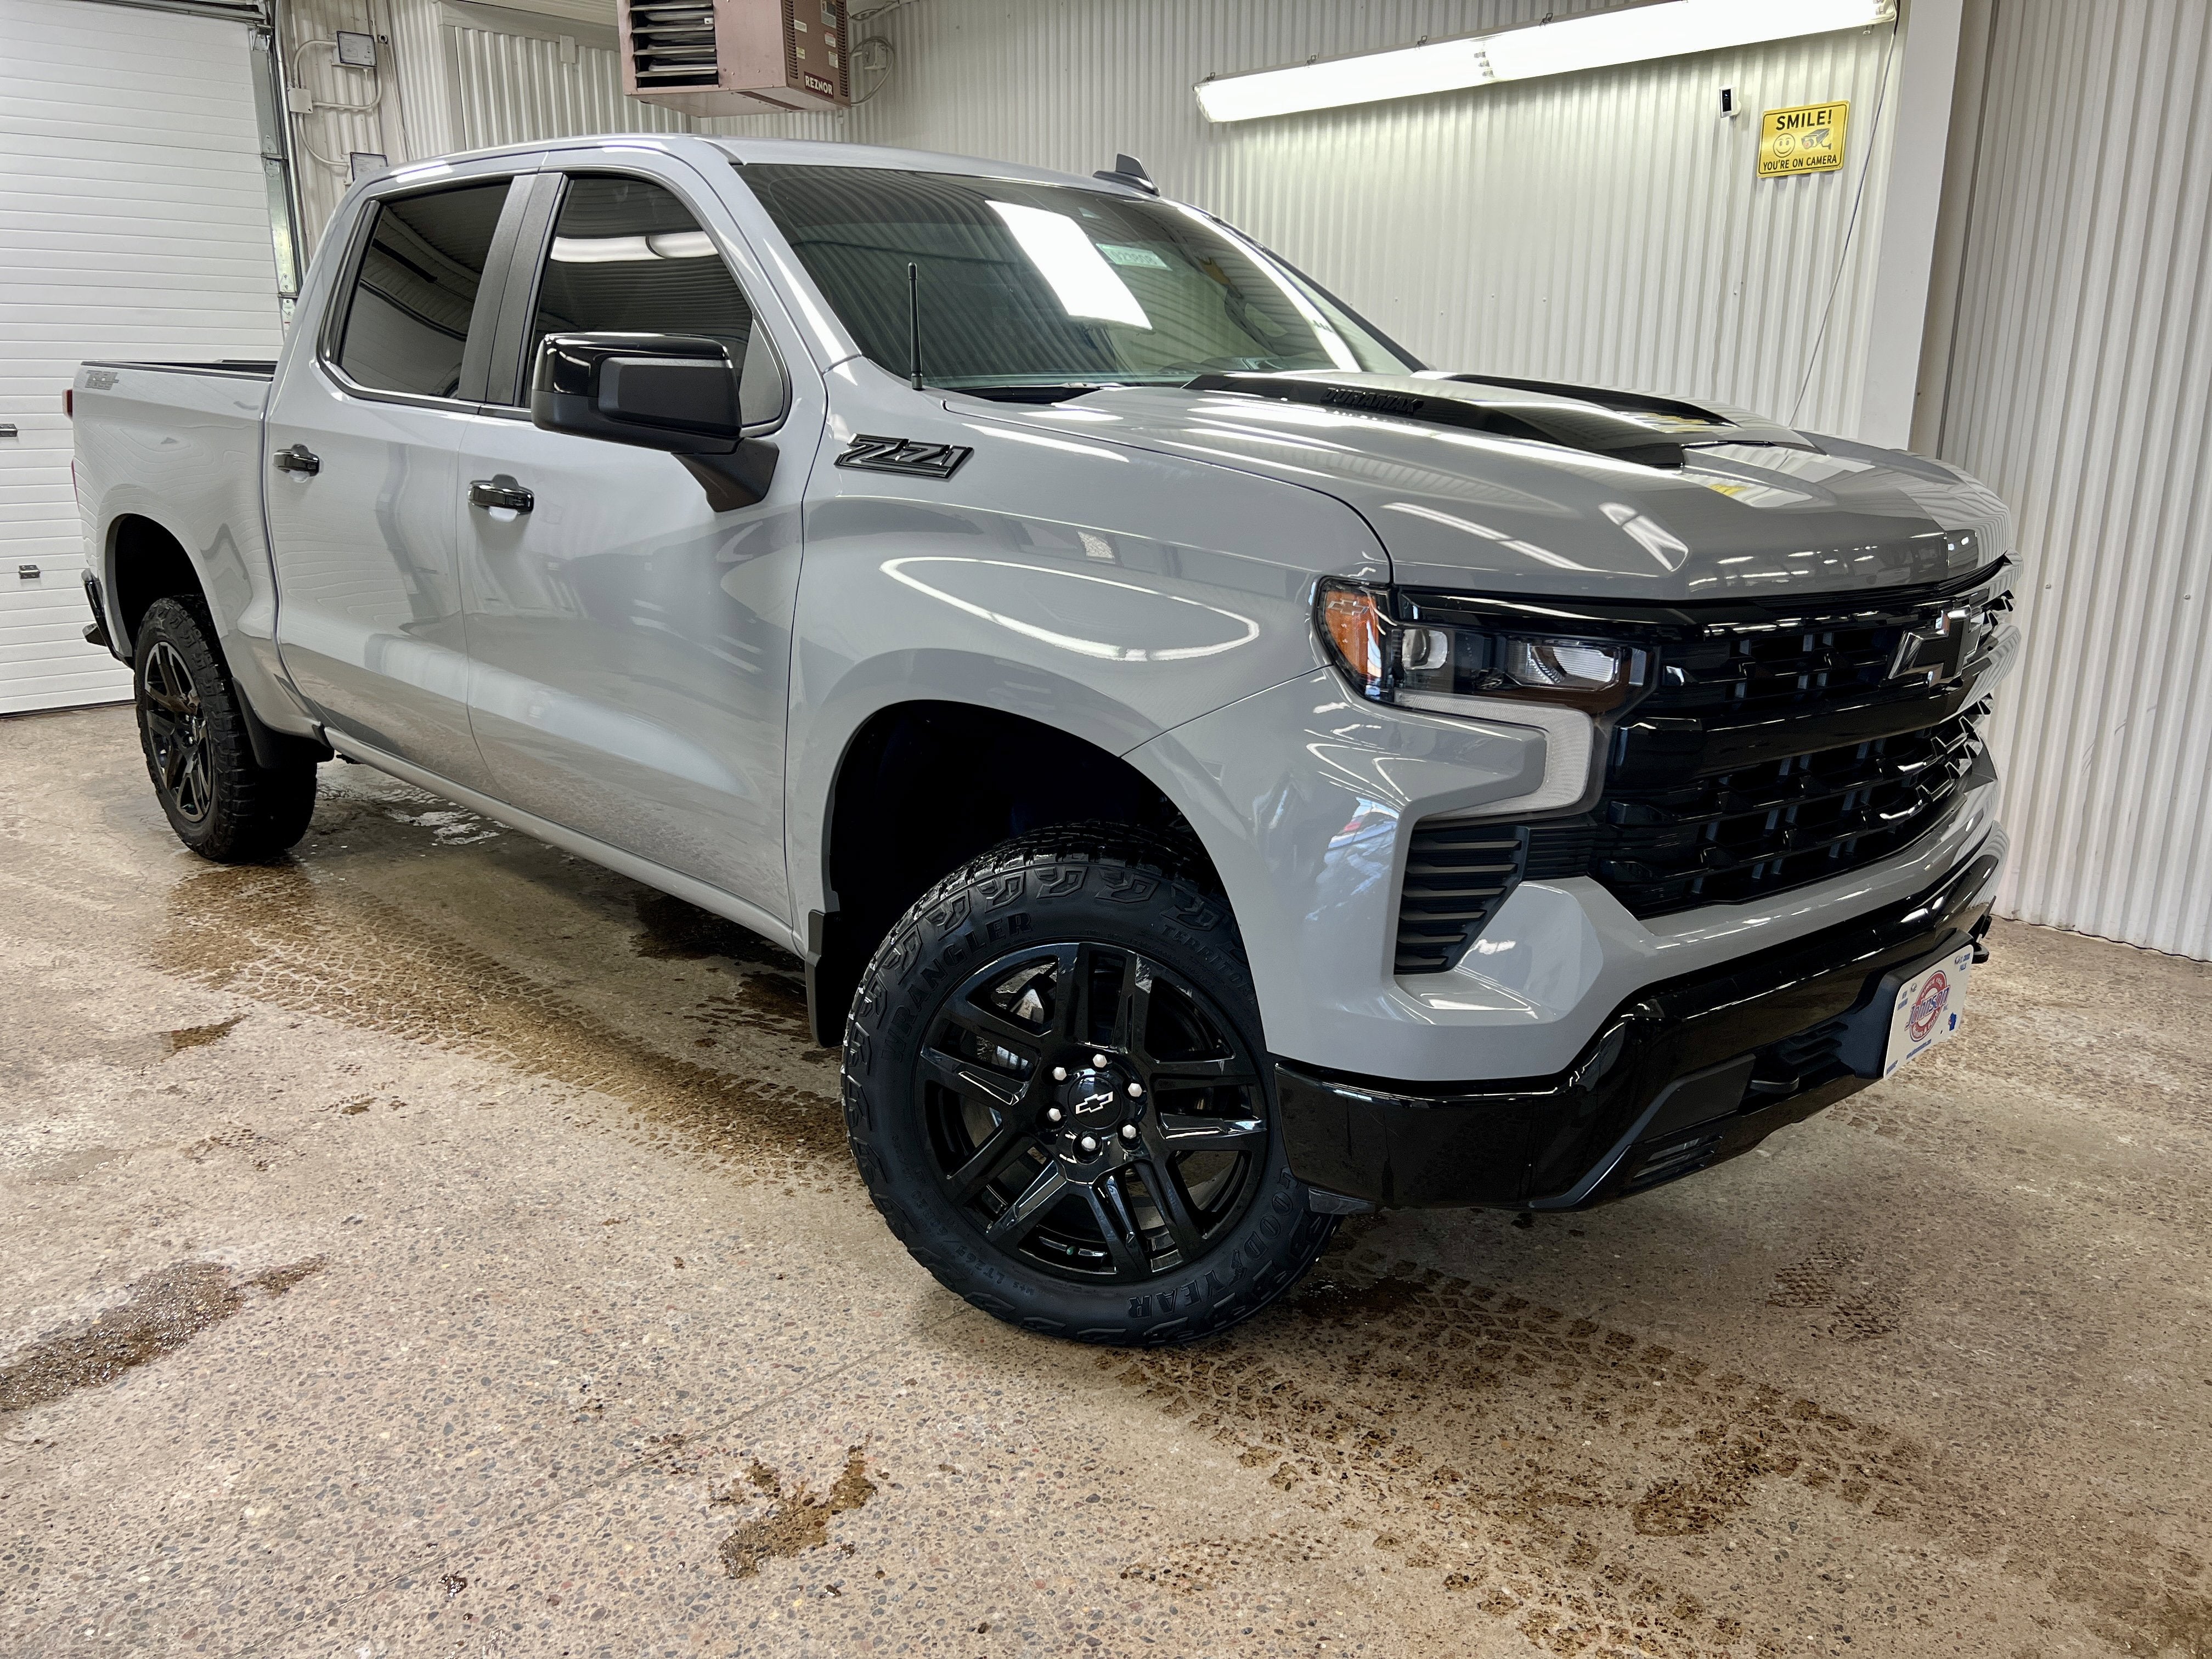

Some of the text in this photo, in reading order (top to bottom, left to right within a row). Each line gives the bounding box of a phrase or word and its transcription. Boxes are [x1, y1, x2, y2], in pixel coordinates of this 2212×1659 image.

[805, 75, 834, 95] REZNOR
[1775, 109, 1833, 131] SMILE!
[1763, 154, 1837, 171] YOU'RE ON CAMERA
[1319, 387, 1419, 413] DURAMAX
[833, 433, 974, 479] Z71
[880, 911, 1033, 1063] WRANGLER
[1905, 986, 1950, 1030] Johnson
